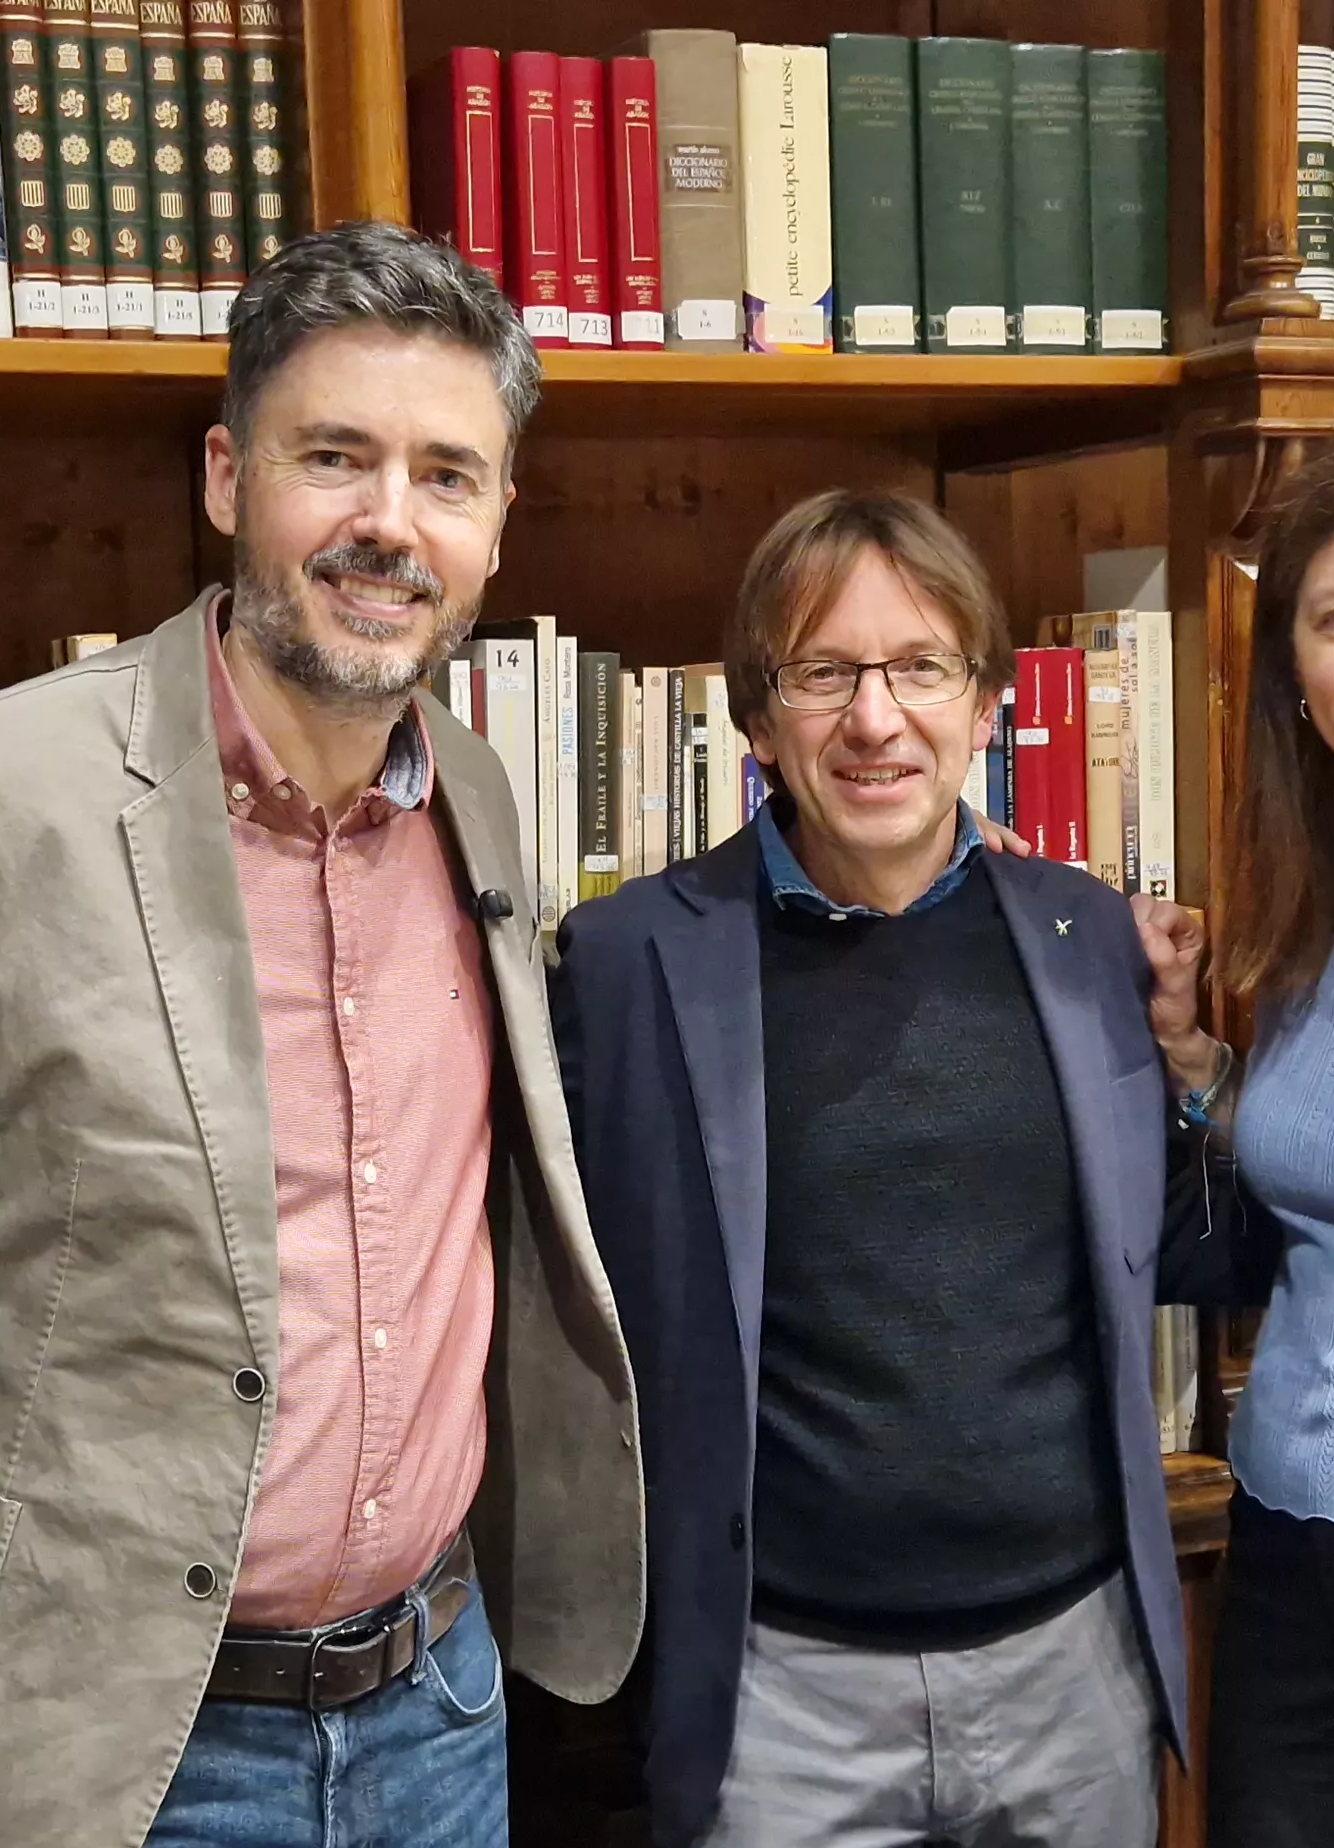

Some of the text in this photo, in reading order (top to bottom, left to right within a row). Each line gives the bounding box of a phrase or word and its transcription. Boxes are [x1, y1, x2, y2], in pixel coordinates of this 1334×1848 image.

[140, 2, 182, 25] ESPAÑA
[190, 2, 233, 24] ESPAÑA
[669, 156, 728, 167] DICCIONARIO
[671, 166, 724, 179] DEL ESPAÑOL
[779, 58, 803, 297] petite encyclopédie Larousse
[675, 178, 723, 189] MODERNO
[534, 311, 564, 328] 714
[581, 318, 609, 336] 713
[496, 649, 520, 668] 14
[1129, 674, 1139, 693] sol
[561, 646, 574, 755] PASIONES Rosa Montero
[1120, 657, 1131, 730] mujeres de
[674, 700, 682, 712] LA
[595, 663, 608, 853] EL FRAILE Y LA INQUISICIÓN
[673, 751, 681, 764] DE
